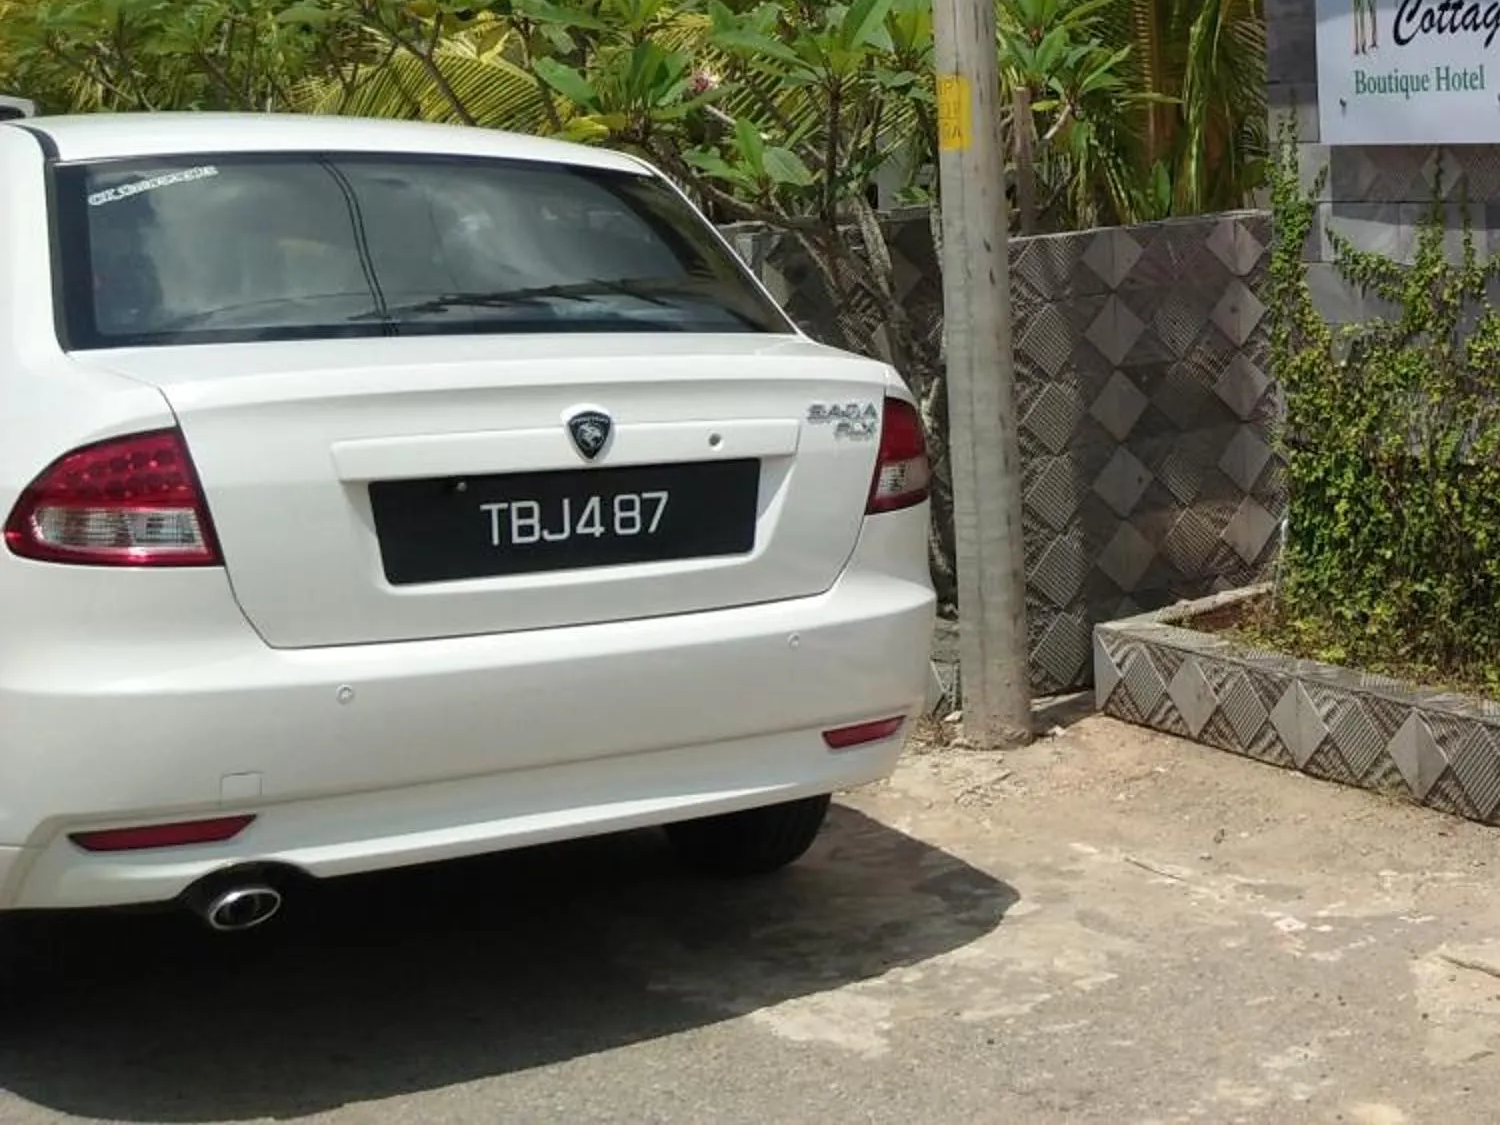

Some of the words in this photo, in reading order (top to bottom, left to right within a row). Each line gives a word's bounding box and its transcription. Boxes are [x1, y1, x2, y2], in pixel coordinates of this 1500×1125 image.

[1354, 68, 1430, 100] Boutique
[1436, 64, 1486, 92] Hotel
[480, 490, 669, 545] TBJ487
